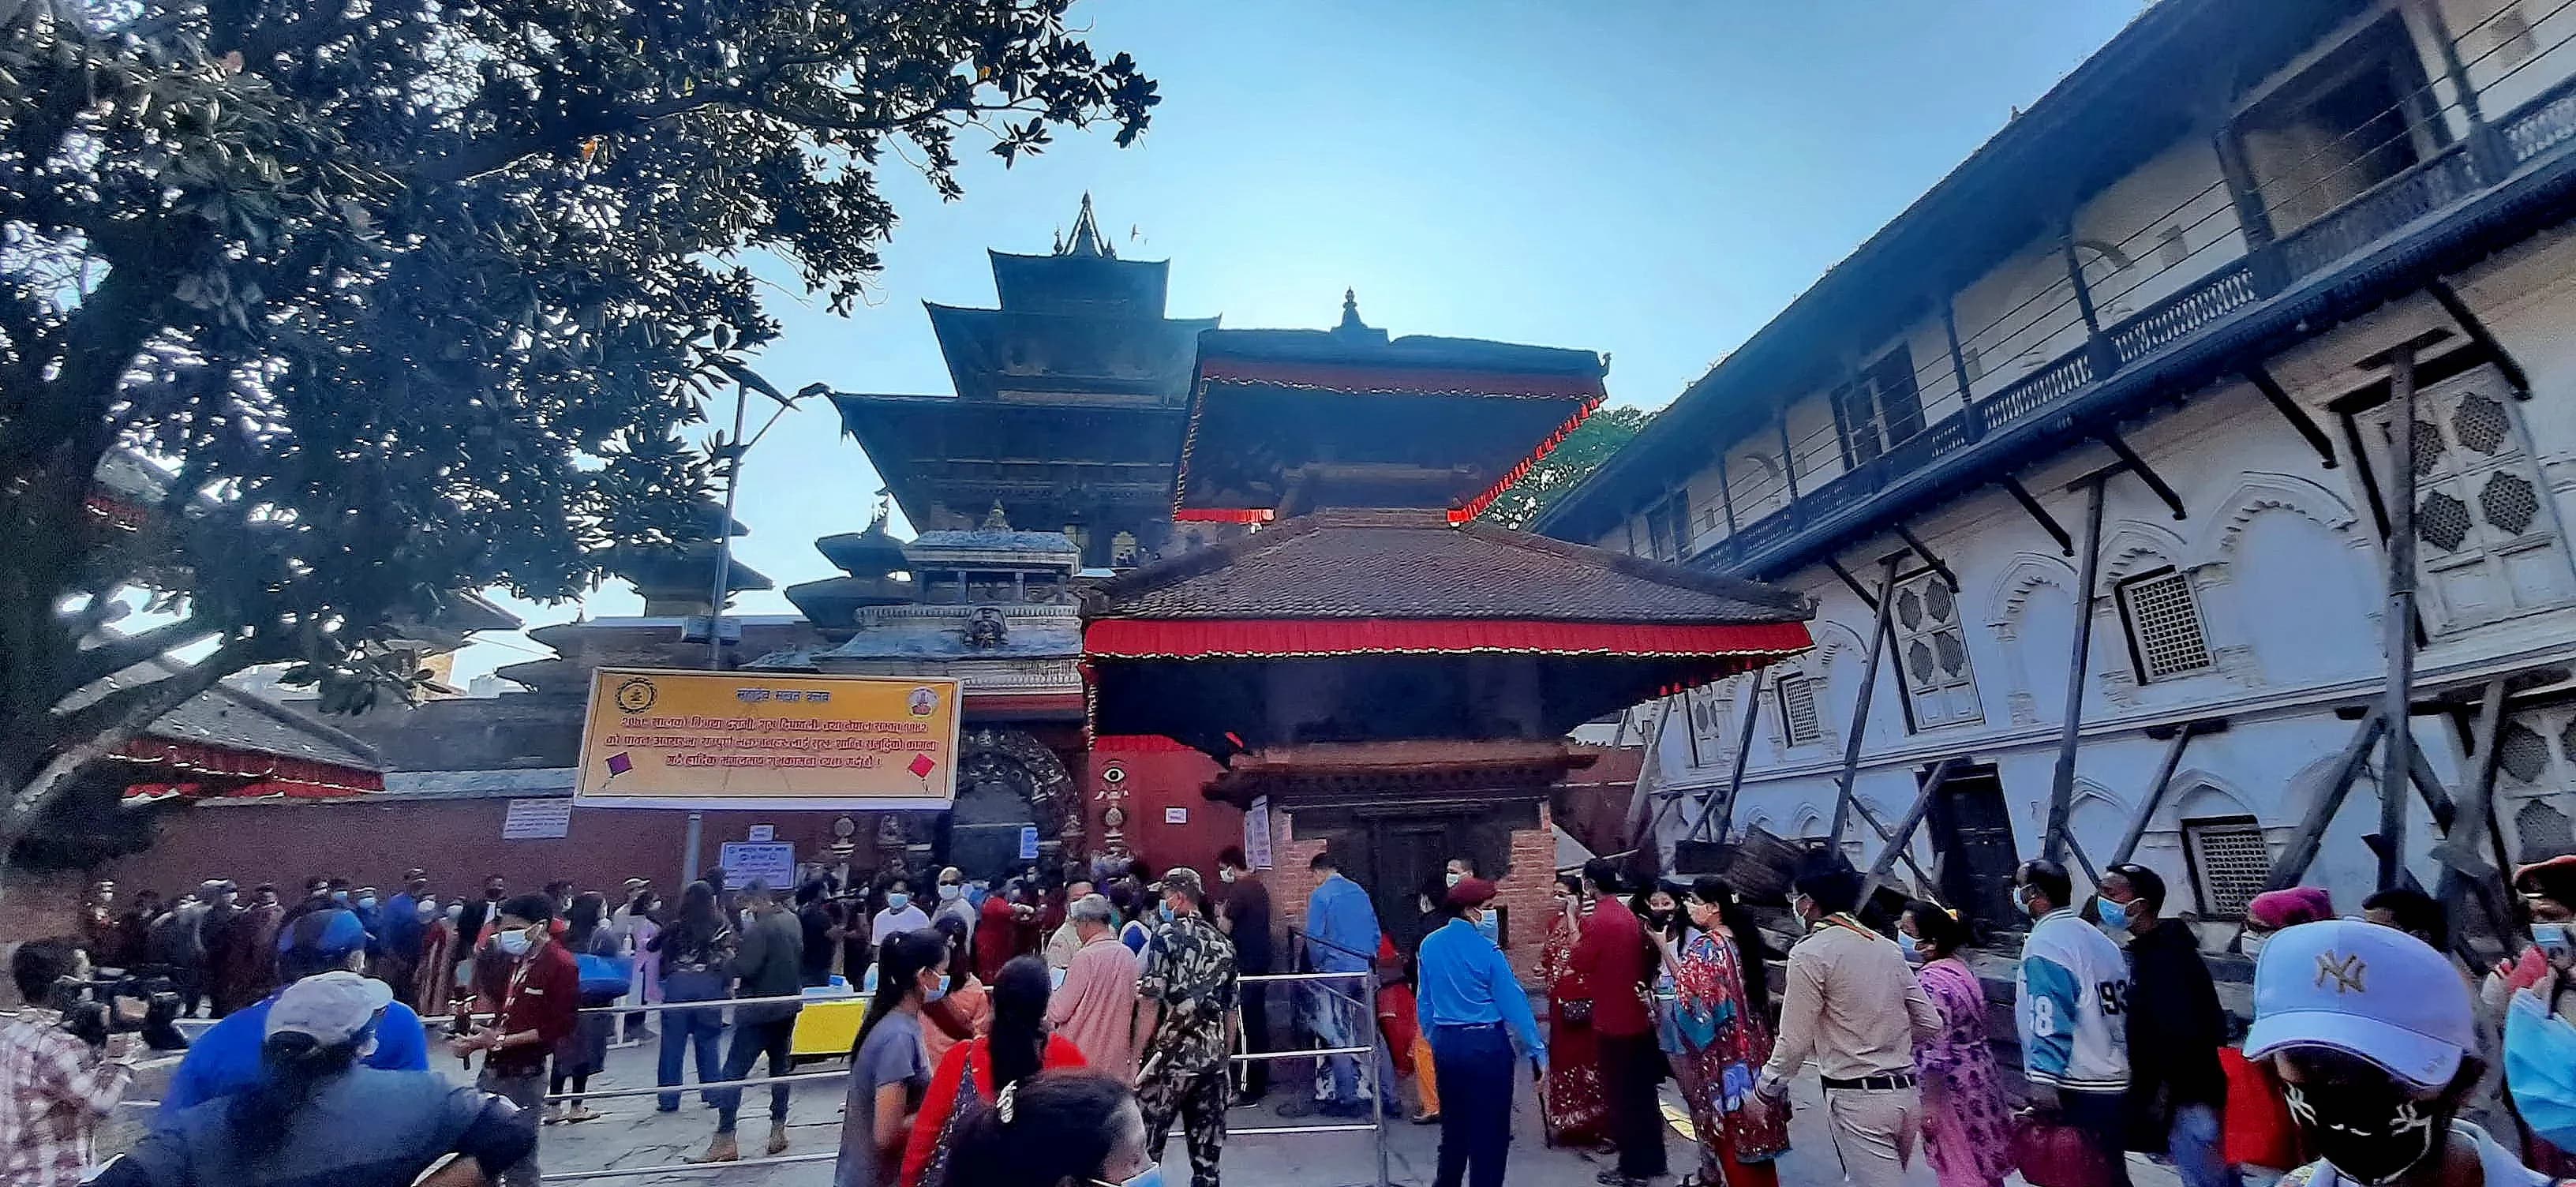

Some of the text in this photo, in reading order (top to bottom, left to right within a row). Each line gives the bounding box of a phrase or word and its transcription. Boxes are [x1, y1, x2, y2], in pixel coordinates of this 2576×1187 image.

[822, 720, 841, 732] तथा
[844, 719, 871, 732] नेपाल
[653, 735, 696, 747] अवसरमा
[905, 740, 937, 752] कामना
[685, 752, 717, 766] हार्दिक
[767, 755, 816, 769] शुभकामना
[2314, 949, 2368, 994] NY
